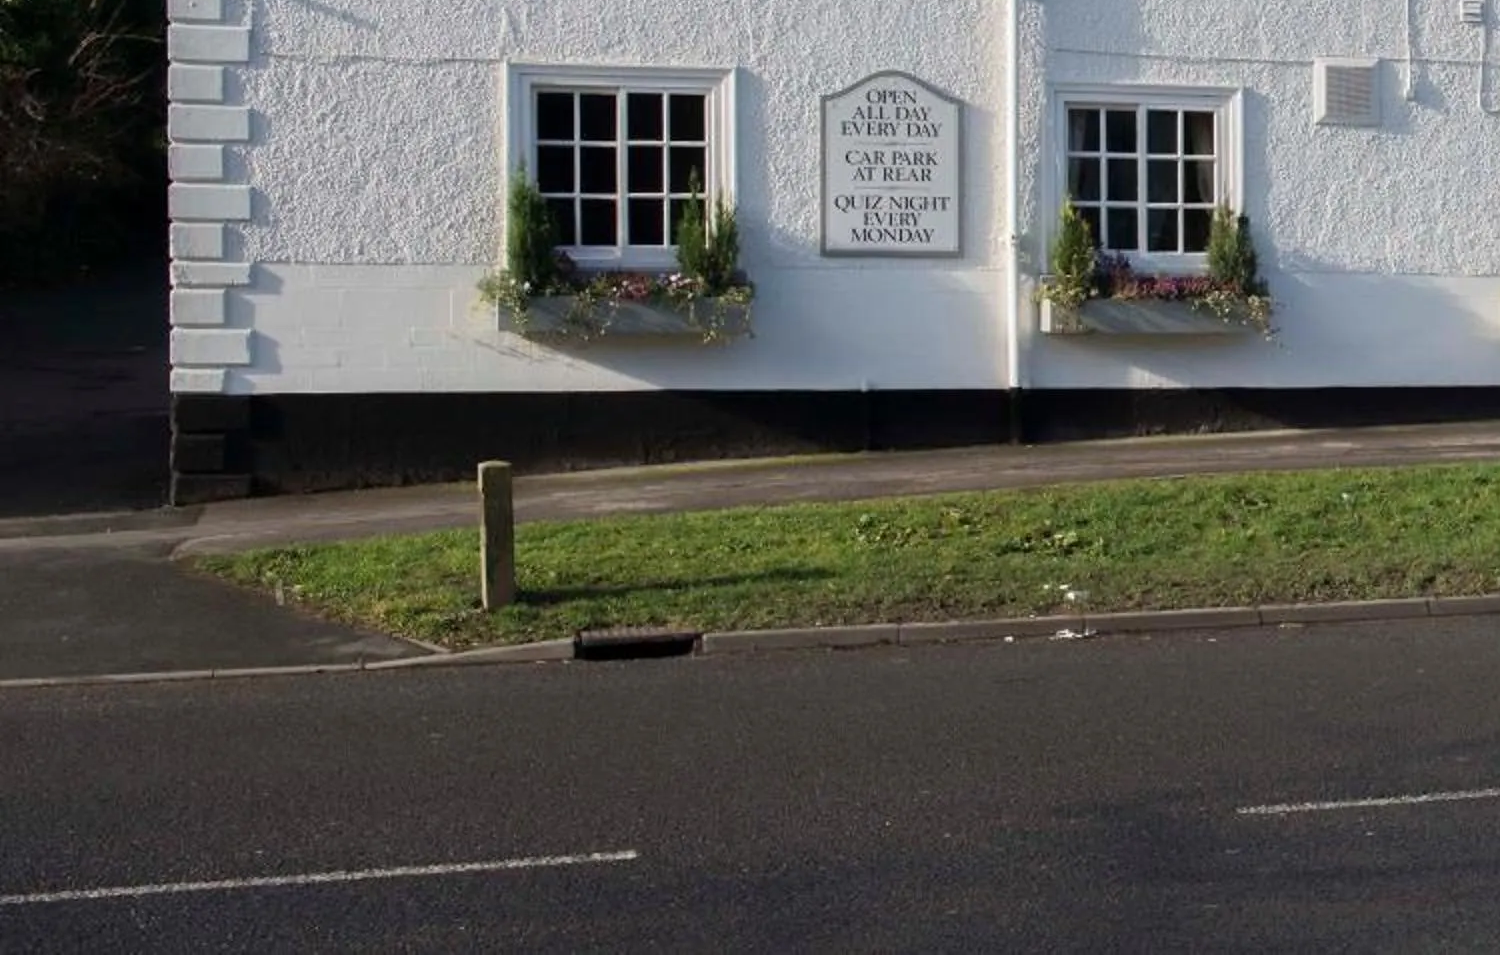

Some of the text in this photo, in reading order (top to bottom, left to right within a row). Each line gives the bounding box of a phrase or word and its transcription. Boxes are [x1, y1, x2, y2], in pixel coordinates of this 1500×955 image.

[866, 88, 917, 105] OPEN
[852, 106, 932, 122] ALL DAY
[841, 121, 942, 138] EVERY DAY
[845, 150, 939, 166] CAR PARK
[852, 167, 932, 182] AT REAR
[834, 195, 951, 213] QUIZ NIGHT
[863, 212, 922, 227] EVERY
[851, 228, 935, 244] MONDAY
